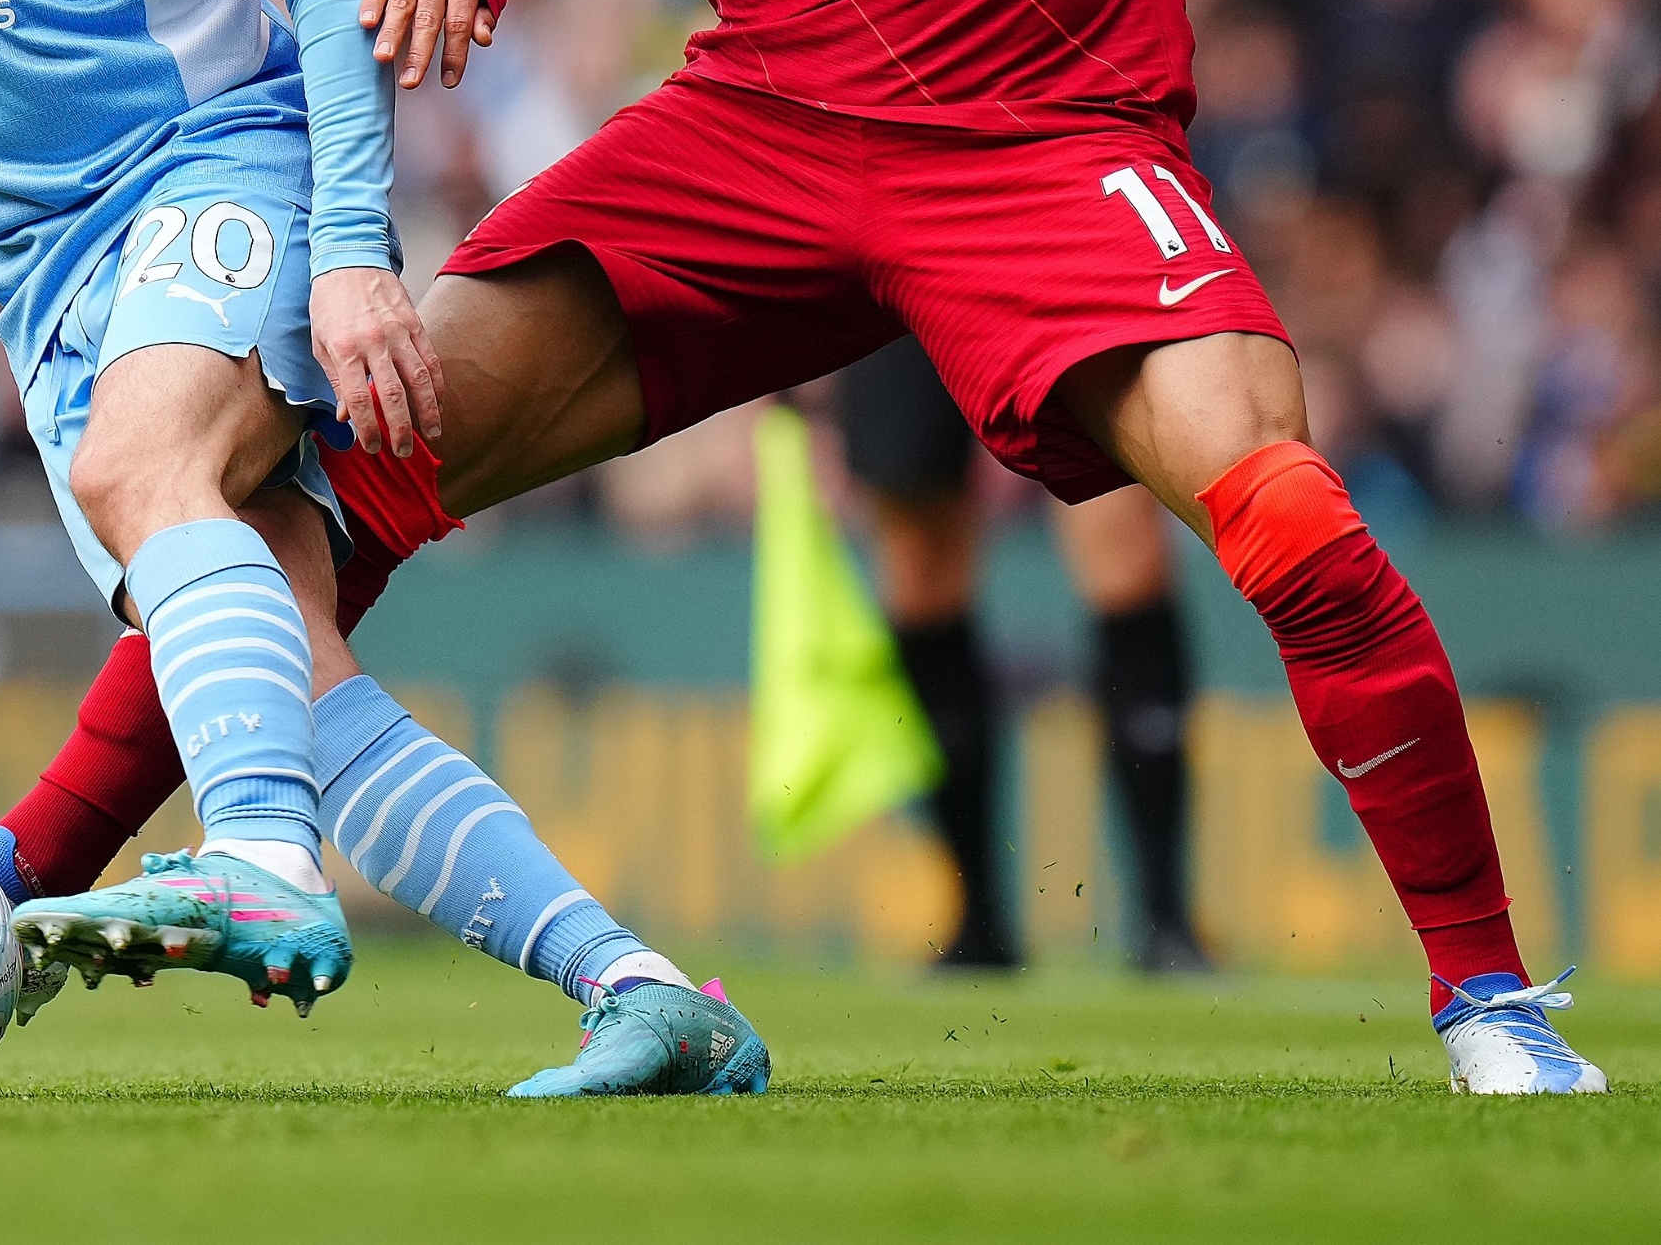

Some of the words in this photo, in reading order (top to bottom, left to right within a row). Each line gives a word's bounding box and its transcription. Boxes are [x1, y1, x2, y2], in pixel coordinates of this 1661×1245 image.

[1099, 163, 1233, 261] 11
[115, 201, 275, 307] 20
[186, 711, 262, 760] CITY
[462, 876, 507, 950] CITY
[708, 1035, 736, 1070] adidas
